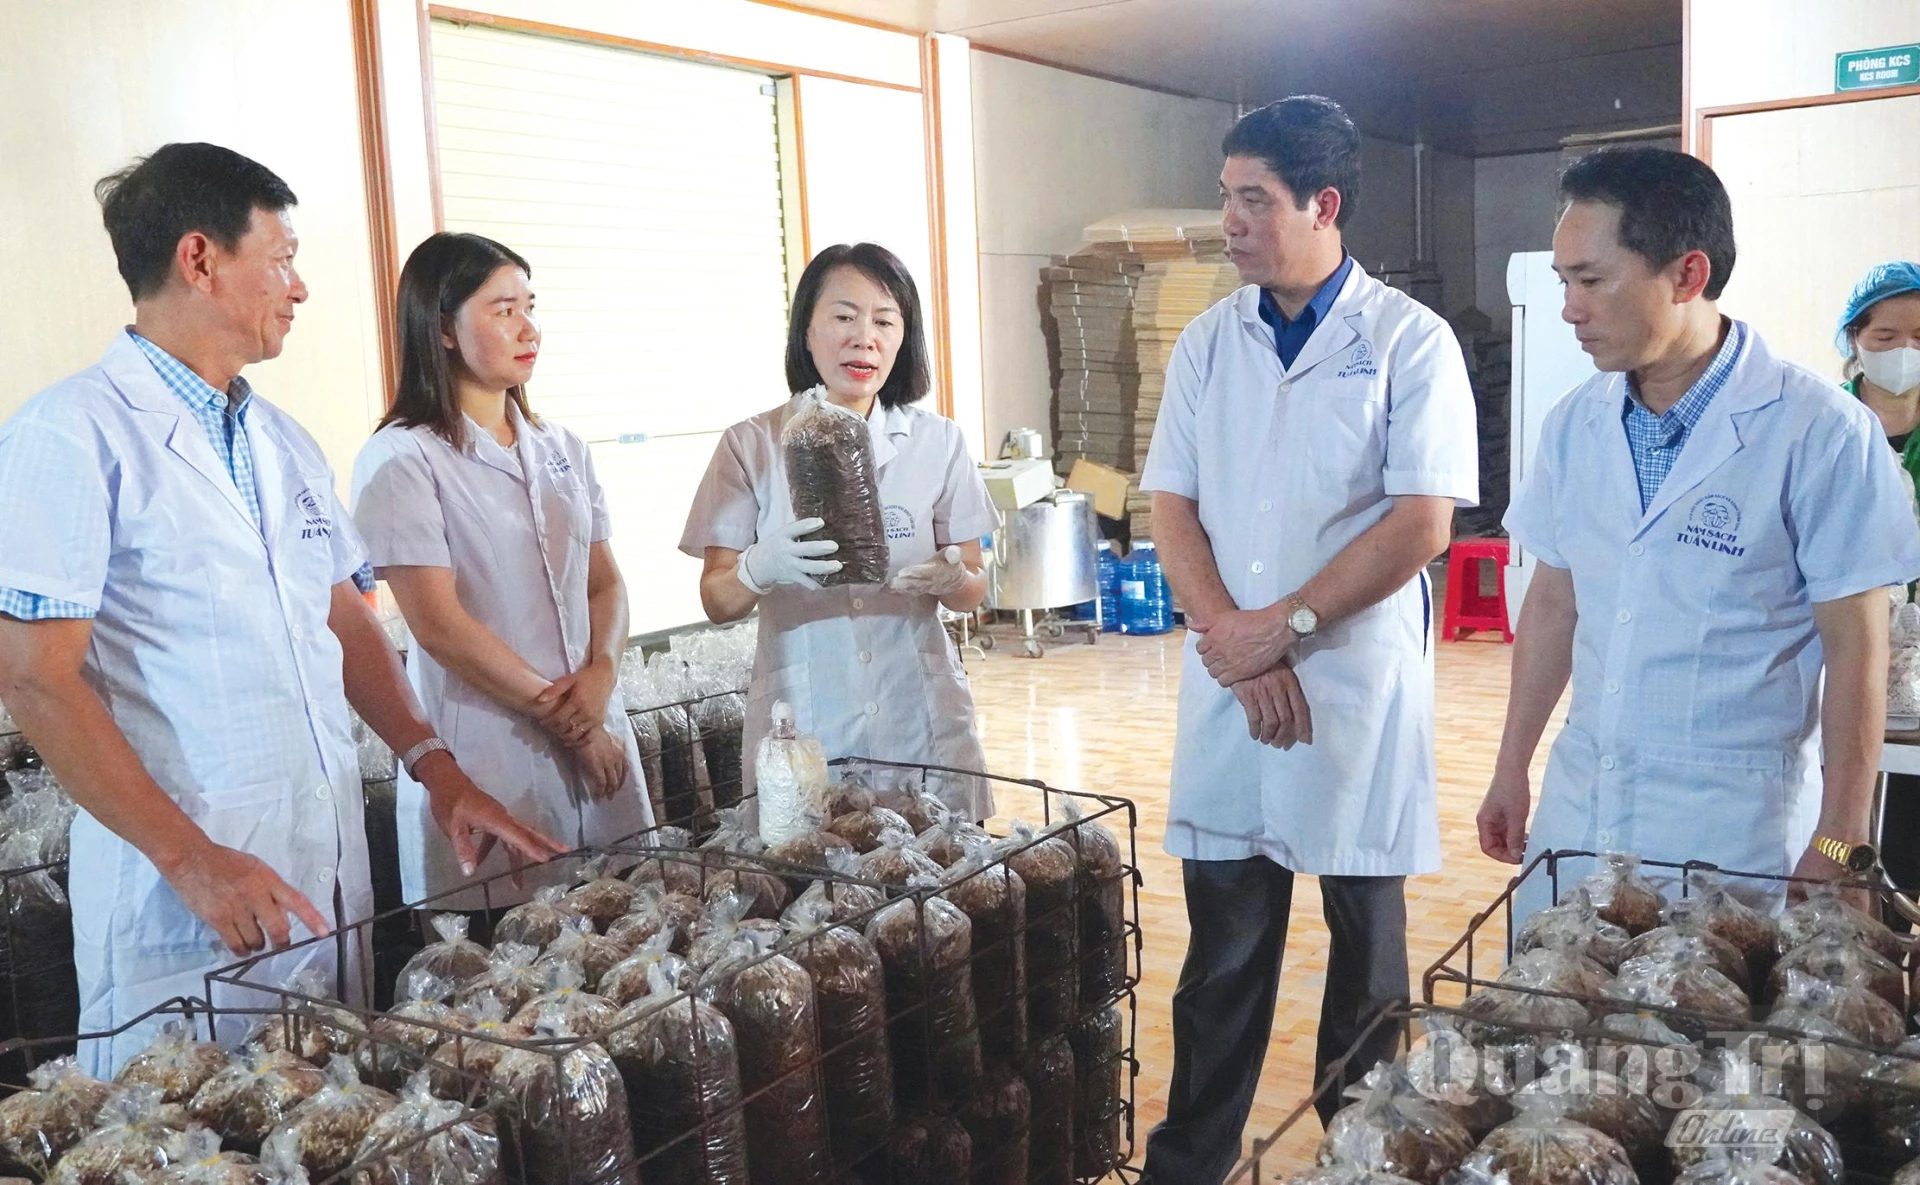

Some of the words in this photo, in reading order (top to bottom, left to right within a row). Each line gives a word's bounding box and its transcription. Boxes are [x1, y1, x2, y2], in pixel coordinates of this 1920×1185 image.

[1848, 57, 1886, 72] PHÒNG
[1889, 54, 1911, 67] KCS
[1859, 72, 1874, 81] KCS
[1876, 69, 1898, 79] ROOM
[1711, 540, 1745, 556] LINH
